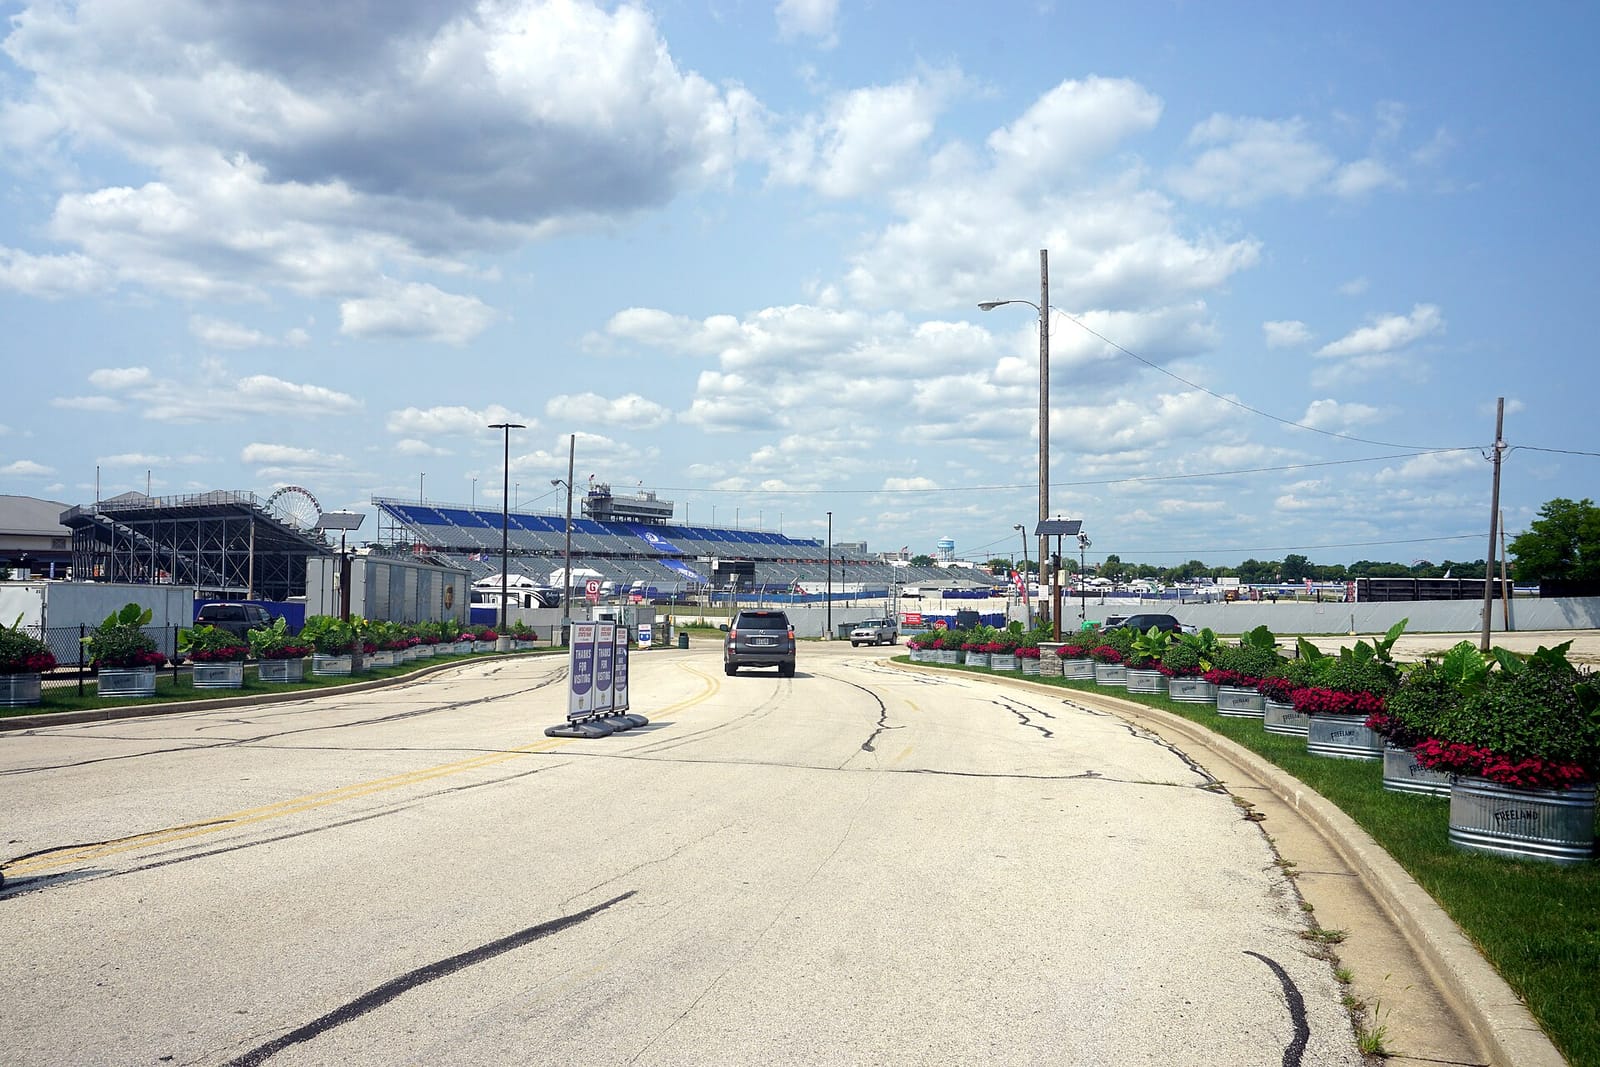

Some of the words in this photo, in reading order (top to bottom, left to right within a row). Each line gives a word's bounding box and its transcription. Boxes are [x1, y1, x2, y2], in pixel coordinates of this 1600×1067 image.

[590, 582, 596, 591] G
[576, 648, 592, 659] THANKS
[598, 648, 611, 658] THANKS
[578, 662, 587, 673] FOR
[574, 674, 591, 684] VISITING
[598, 671, 611, 680] VISITING
[1282, 712, 1301, 723] FREELA
[1494, 810, 1538, 827] FREELAND
